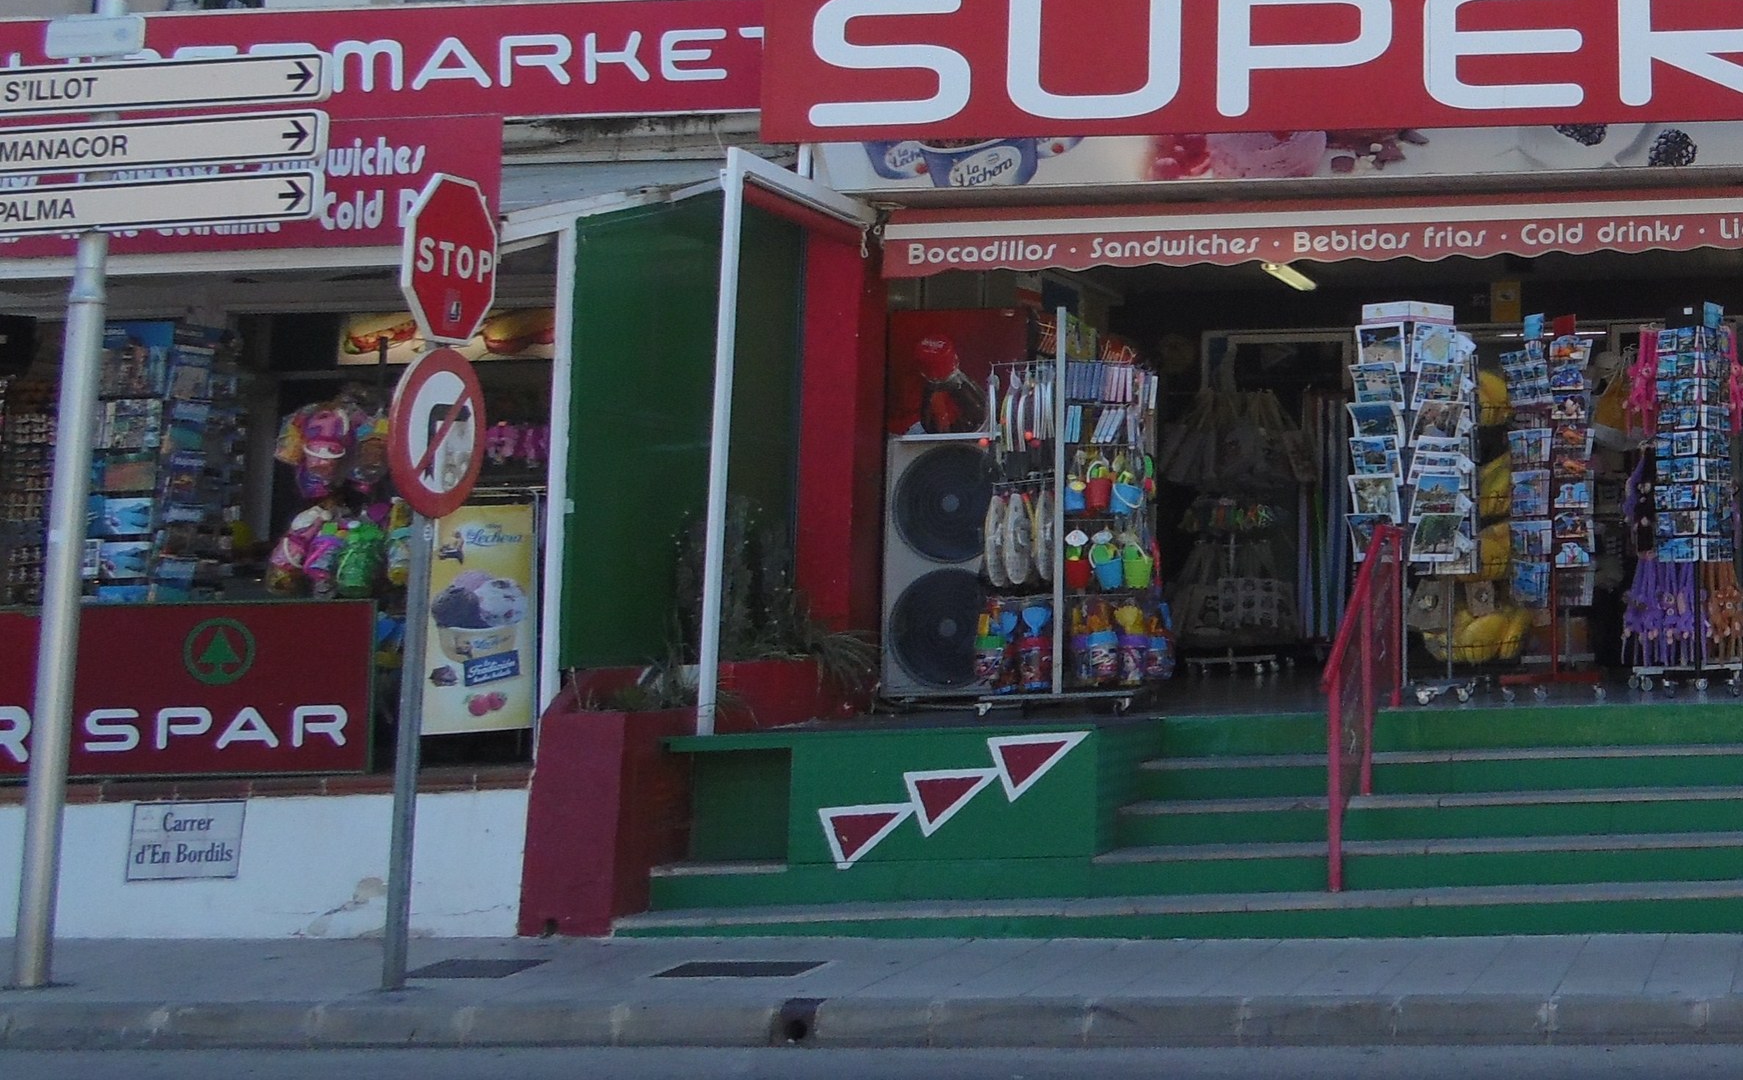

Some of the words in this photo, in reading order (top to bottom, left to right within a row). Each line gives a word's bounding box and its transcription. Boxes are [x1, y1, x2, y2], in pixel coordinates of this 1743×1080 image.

[4, 77, 99, 102] S'ILLOT
[0, 134, 128, 162] MANACOR
[955, 158, 1013, 187] Lechera
[967, 164, 980, 175] La
[319, 189, 384, 231] Cold
[908, 240, 1057, 266] Bocadillos
[1090, 234, 1259, 260] Sandwiches
[1293, 228, 1410, 253] Bebidas
[1424, 225, 1487, 249] frias
[1521, 222, 1583, 245] Cold
[1597, 219, 1684, 244] drinks
[416, 236, 494, 283] STOP
[84, 704, 349, 752] SPAR
[162, 811, 215, 832] Carrer
[135, 843, 171, 865] d'En
[176, 842, 233, 864] Bordils
